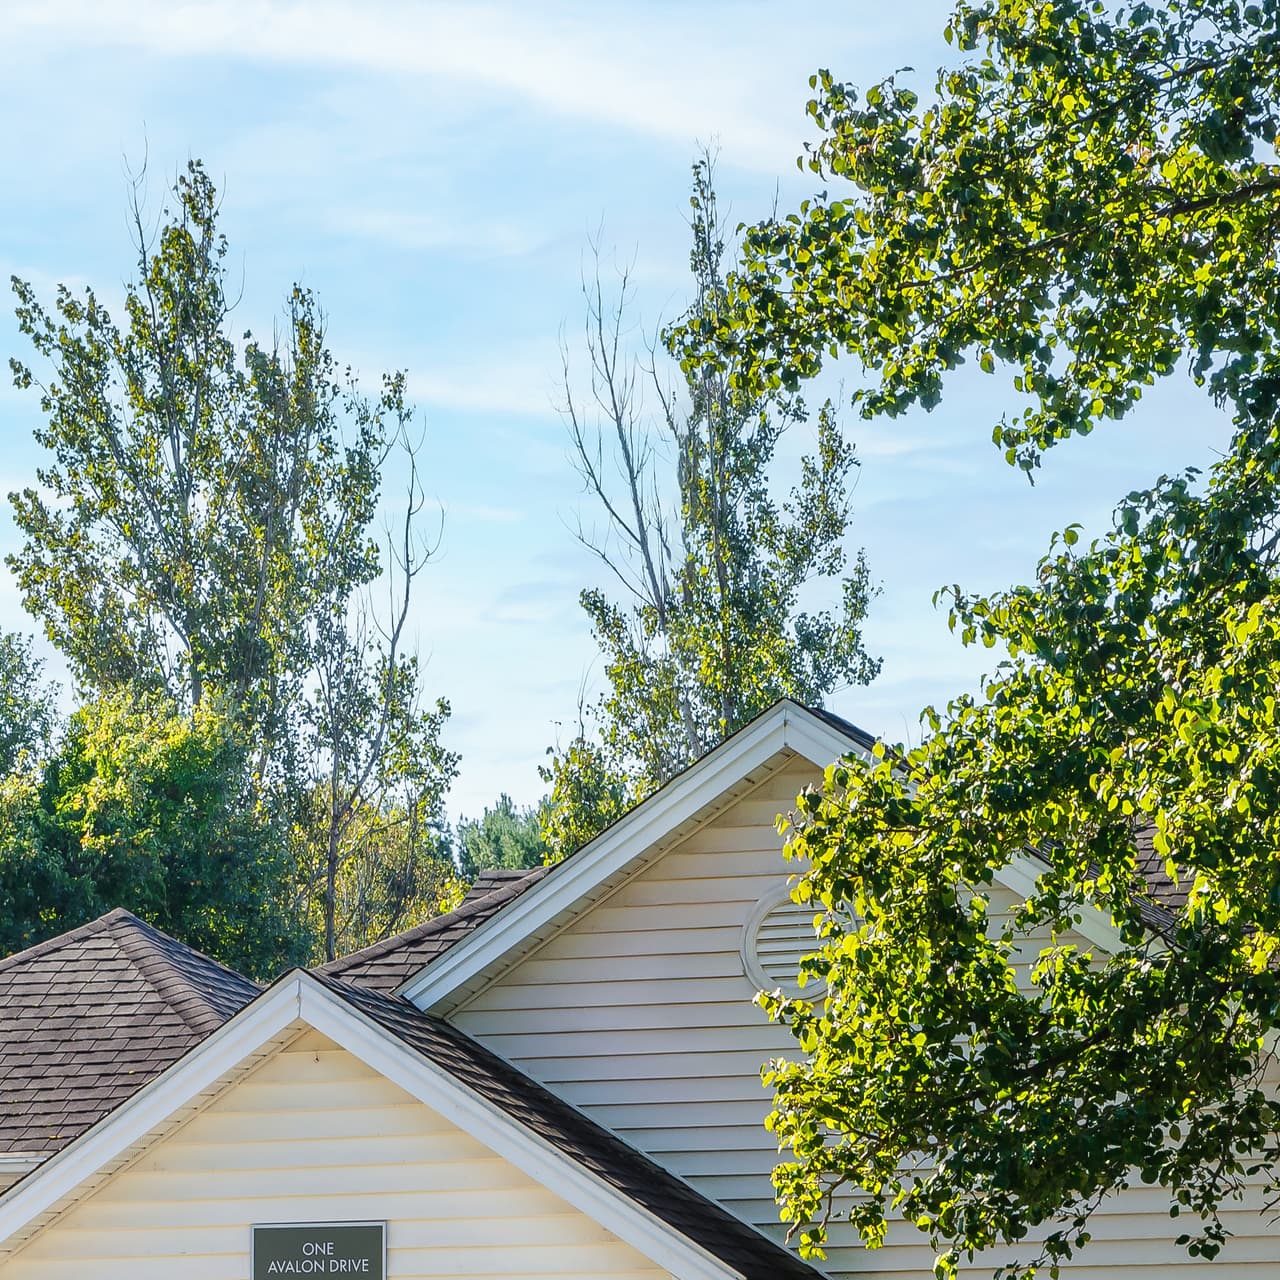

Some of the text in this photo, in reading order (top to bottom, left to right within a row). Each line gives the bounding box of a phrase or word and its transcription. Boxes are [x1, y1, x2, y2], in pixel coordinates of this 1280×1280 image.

[302, 1242, 334, 1256] ONE
[267, 1258, 369, 1273] AVALON DRIVE
